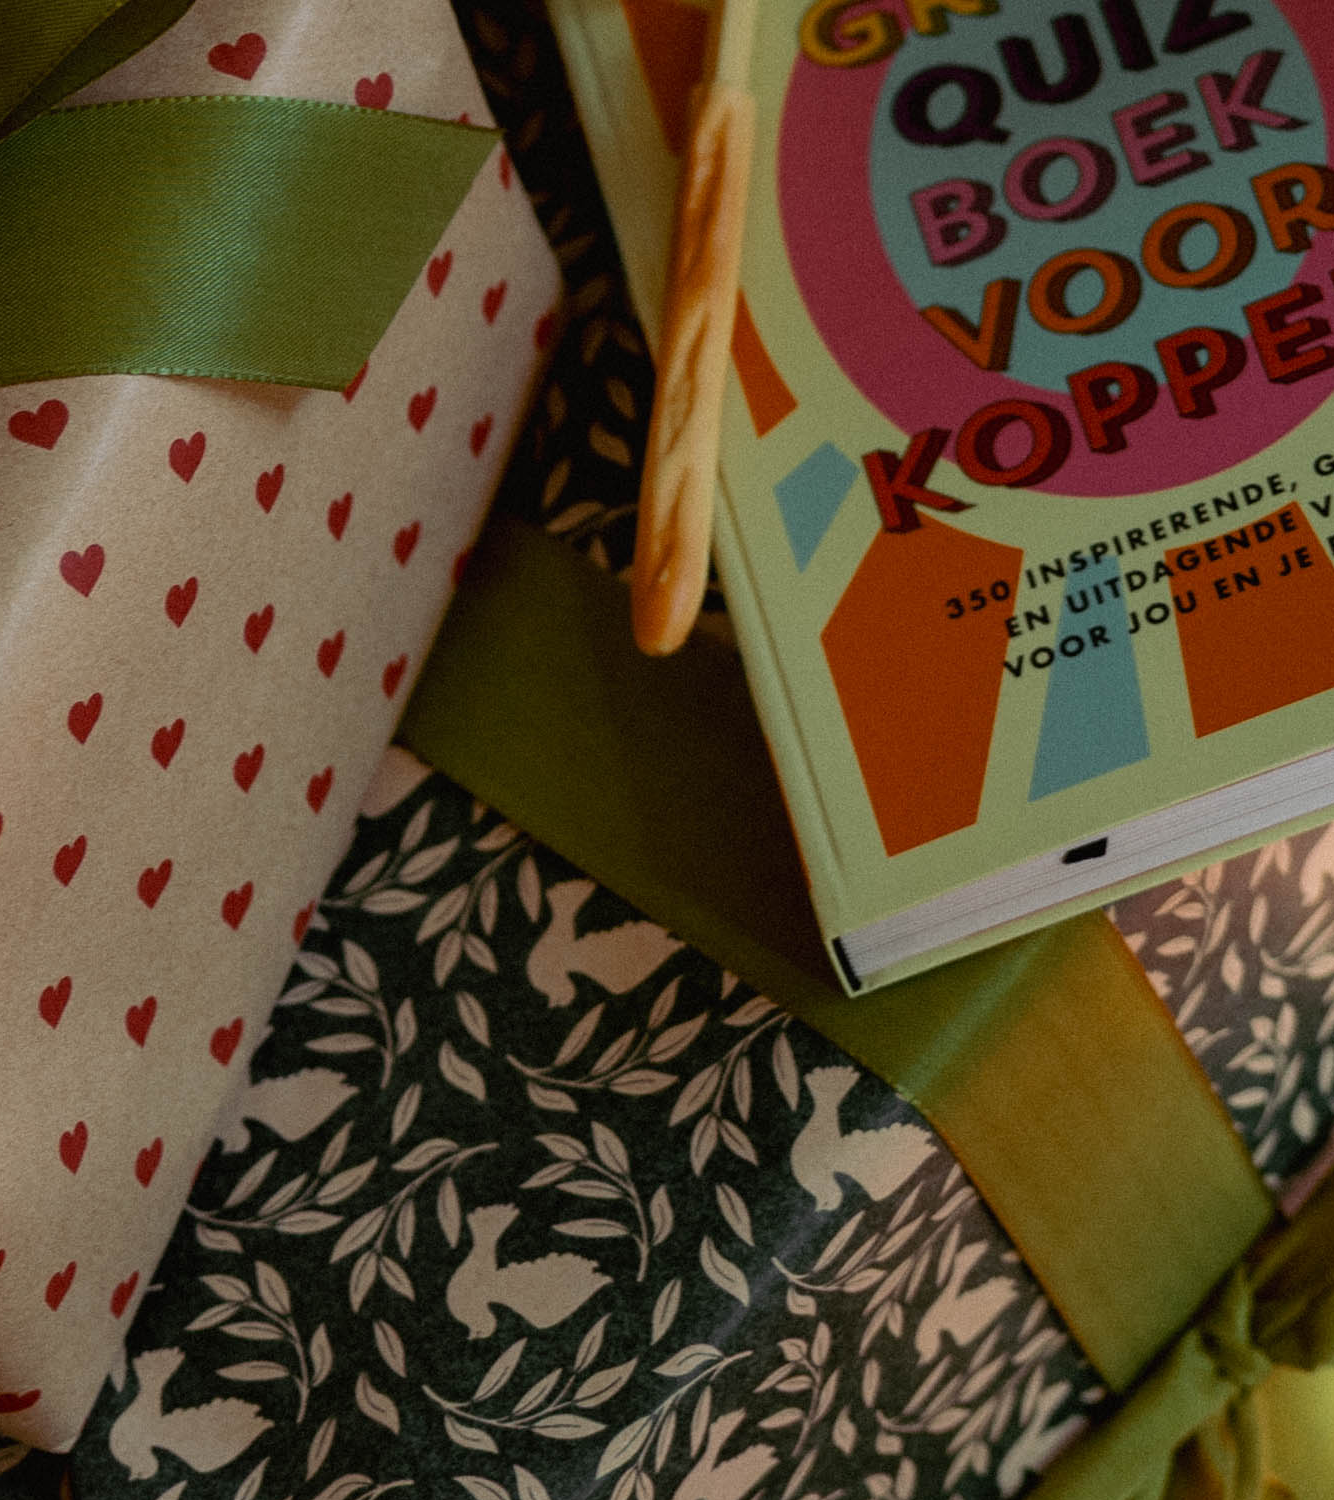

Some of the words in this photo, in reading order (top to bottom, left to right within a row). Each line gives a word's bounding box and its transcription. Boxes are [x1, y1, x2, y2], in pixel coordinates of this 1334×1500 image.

[909, 48, 1311, 268] BOEK
[945, 579, 1011, 620] 350
[1024, 473, 1298, 589] INSPIRERENDE,
[1003, 624, 1112, 679] VOOR
[1128, 589, 1198, 635] JOU
[1213, 566, 1261, 601] EN
[1278, 545, 1315, 577] JE
[1004, 604, 1052, 639] EN
[1066, 510, 1298, 614] UITDAGENDE
